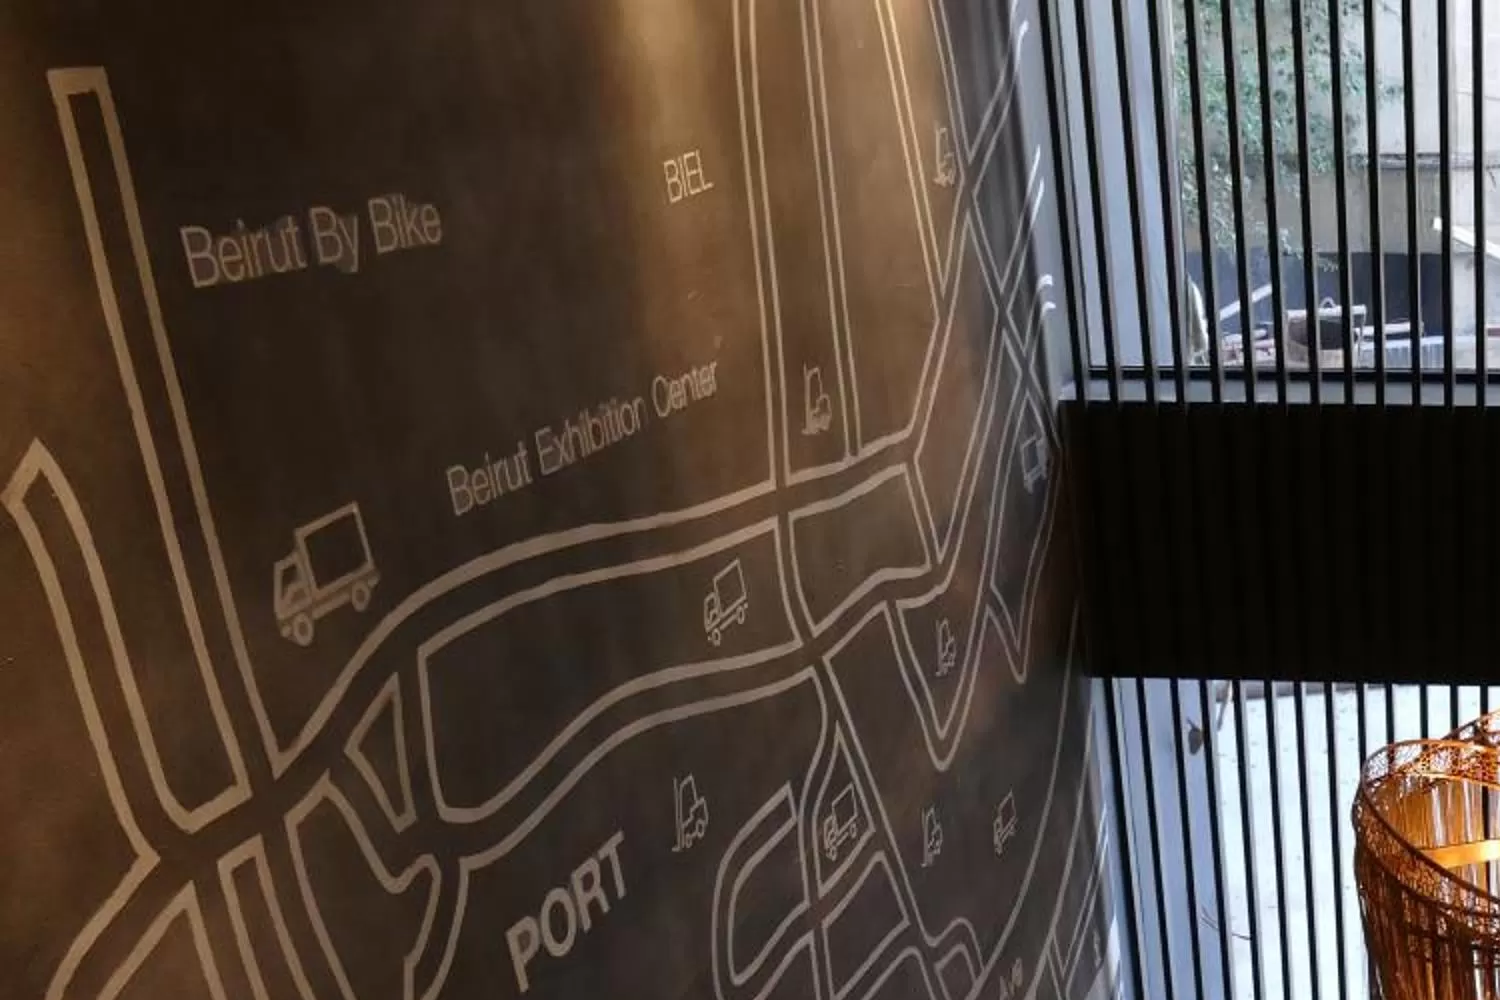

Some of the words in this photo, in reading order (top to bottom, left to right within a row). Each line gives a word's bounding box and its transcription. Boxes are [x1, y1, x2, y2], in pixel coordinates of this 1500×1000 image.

[663, 149, 714, 203] BIEL
[180, 215, 308, 288] Beirut
[309, 206, 359, 273] By
[367, 193, 442, 254] Bike
[446, 440, 534, 516] Beirut
[534, 396, 649, 477] Exhibition
[651, 361, 717, 417] Center
[505, 829, 627, 993] PORT
